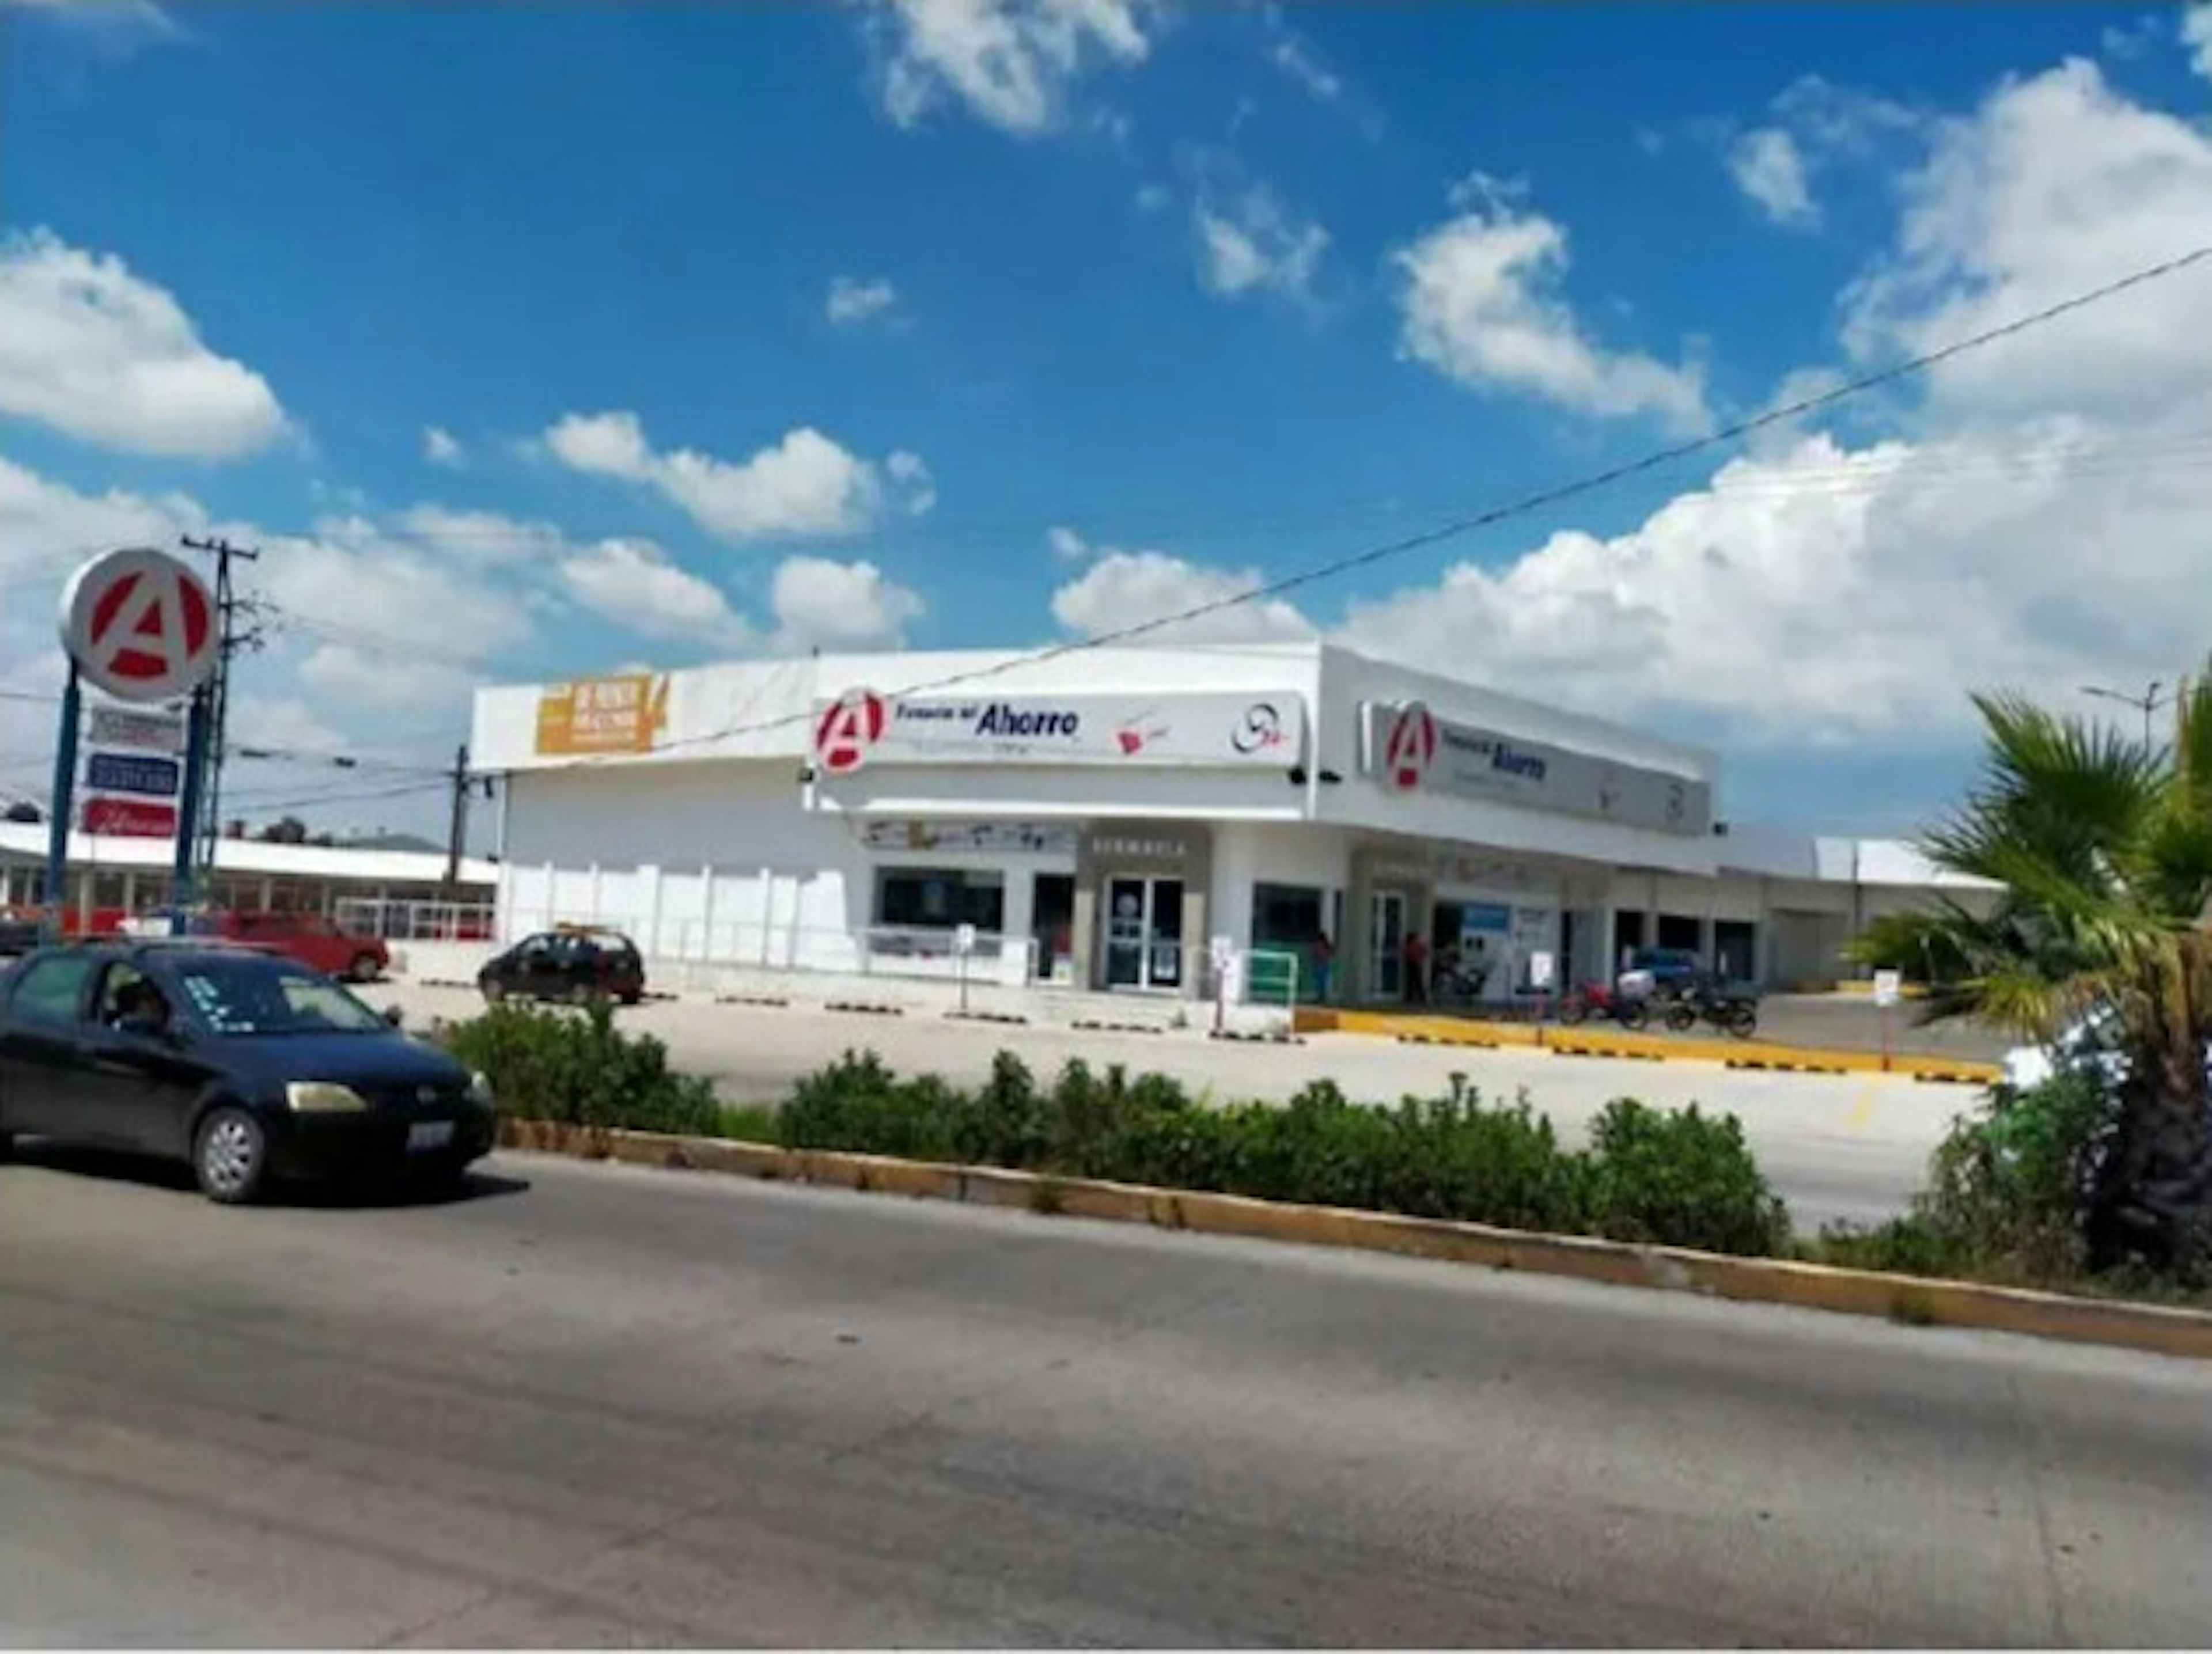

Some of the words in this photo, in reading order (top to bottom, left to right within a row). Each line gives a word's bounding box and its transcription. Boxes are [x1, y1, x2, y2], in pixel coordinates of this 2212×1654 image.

[92, 569, 199, 677] A
[818, 691, 877, 766] A
[975, 704, 1079, 735] Ahorro
[1387, 707, 1431, 784] A
